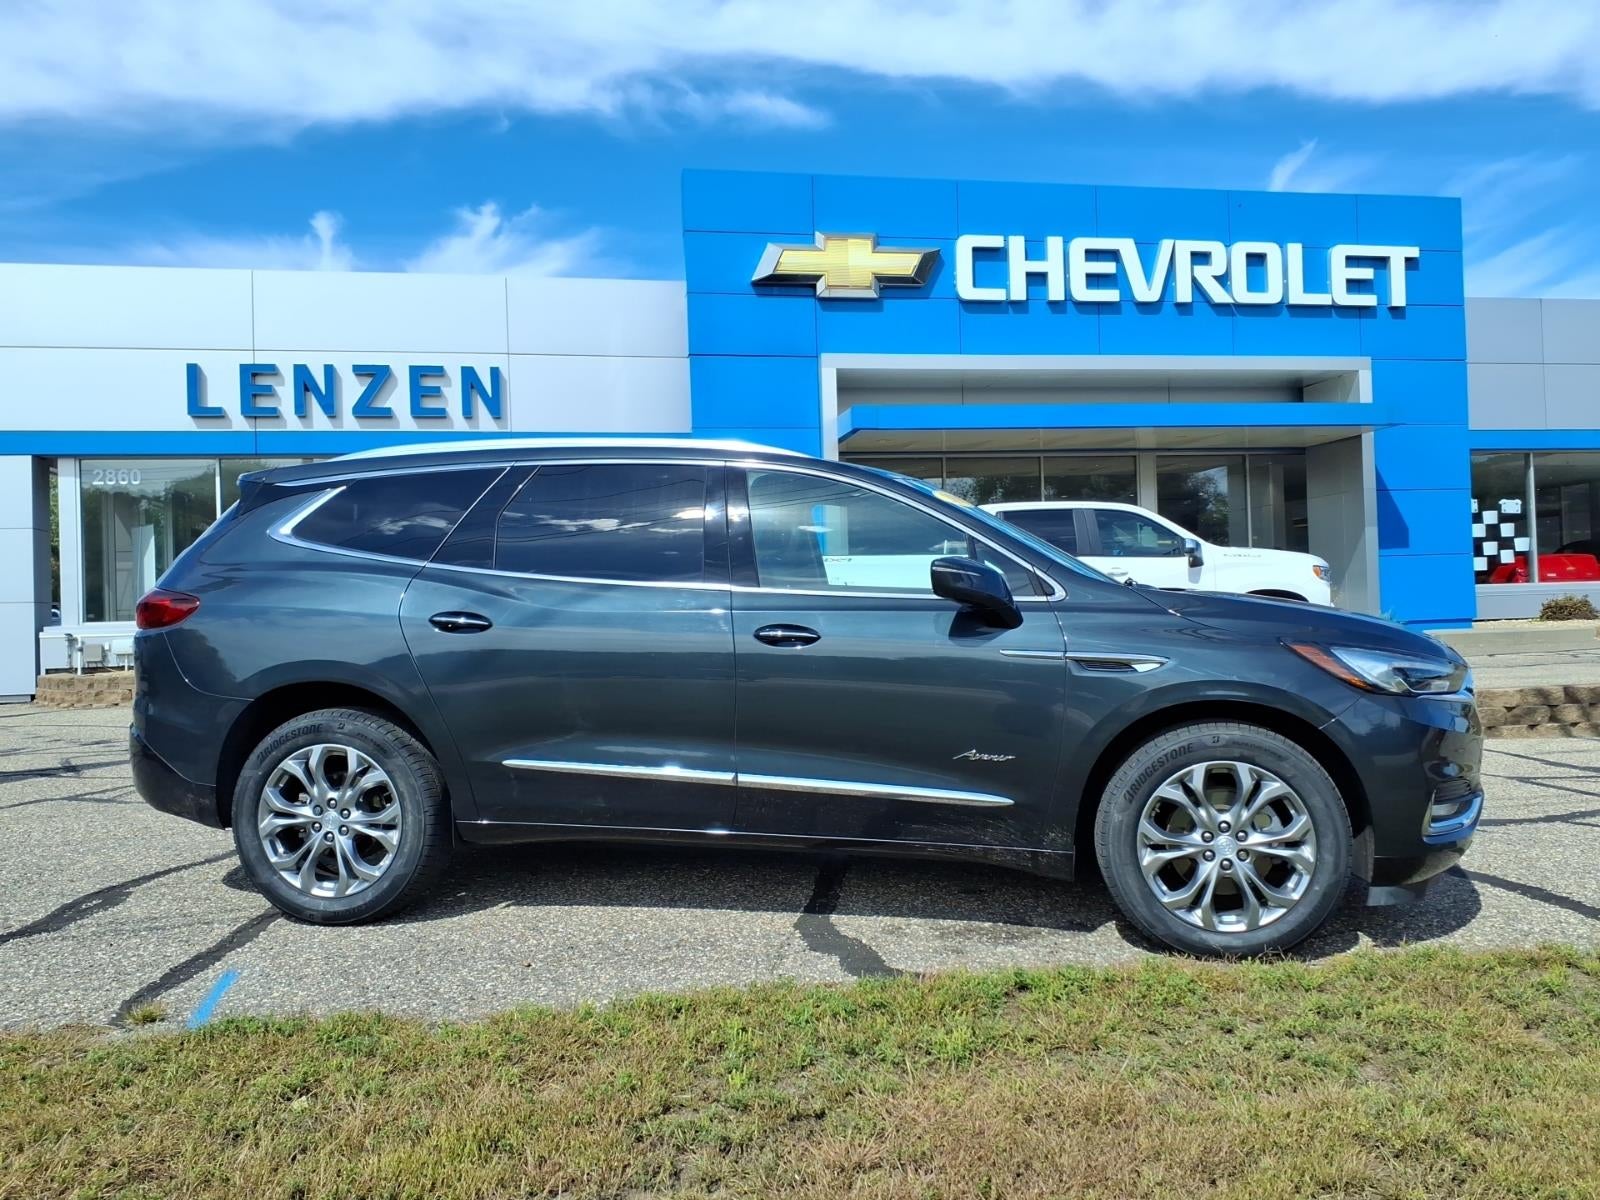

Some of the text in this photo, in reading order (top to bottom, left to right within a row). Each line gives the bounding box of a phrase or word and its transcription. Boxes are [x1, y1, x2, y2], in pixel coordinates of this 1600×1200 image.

[955, 234, 1420, 307] CHEVROLET
[186, 363, 502, 419] LENZEN
[92, 469, 141, 485] 2860
[257, 723, 324, 762] BRIDGESTONE
[1123, 742, 1194, 804] BRIDGESTONE
